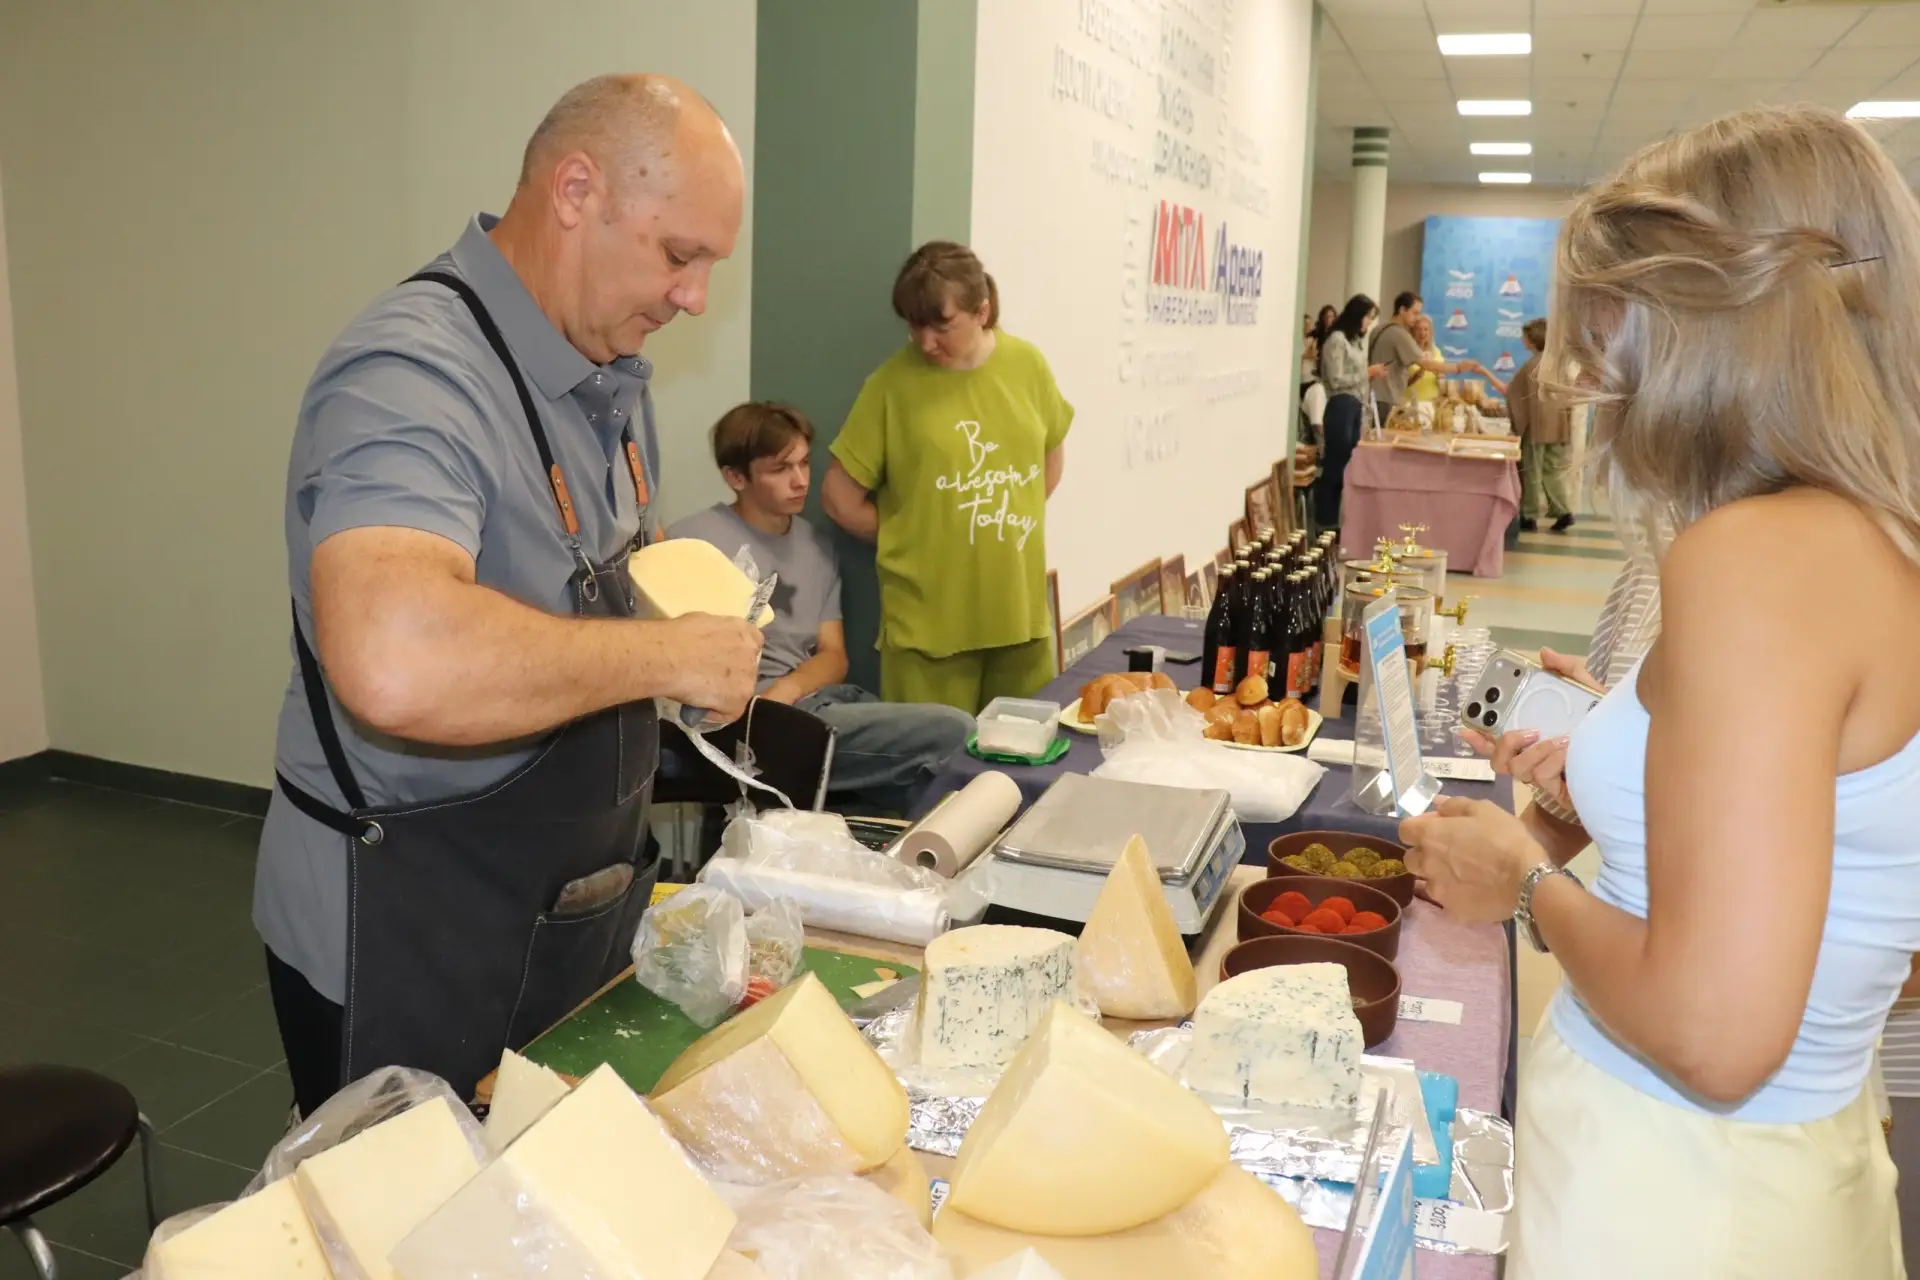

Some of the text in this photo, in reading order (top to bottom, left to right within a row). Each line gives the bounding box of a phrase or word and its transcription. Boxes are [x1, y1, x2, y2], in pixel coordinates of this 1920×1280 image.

[1214, 220, 1263, 311] Арена
[955, 420, 1000, 477] Be
[936, 463, 1041, 497] awesome
[957, 489, 1038, 552] Today
